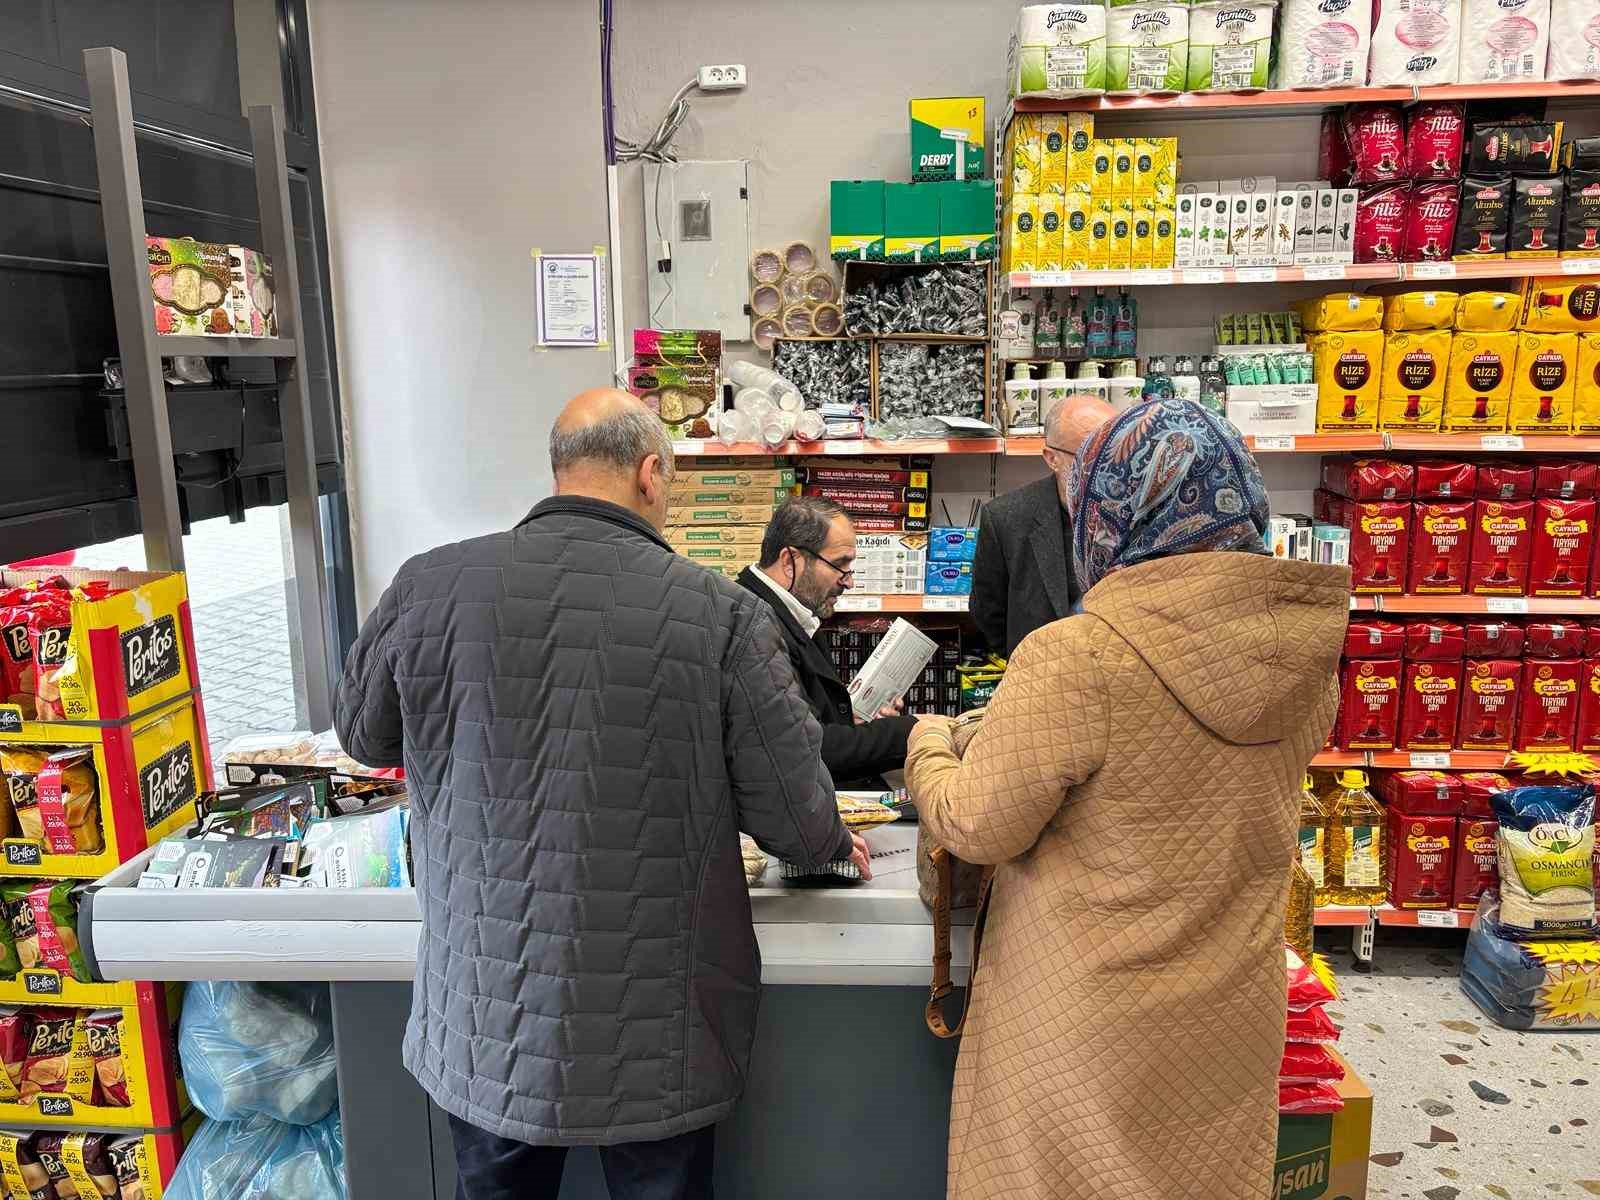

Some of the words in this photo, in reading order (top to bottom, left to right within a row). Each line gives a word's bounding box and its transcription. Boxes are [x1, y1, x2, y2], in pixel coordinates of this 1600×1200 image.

[1047, 8, 1087, 29] familia
[1132, 11, 1170, 30] familia
[1216, 8, 1256, 29] familia
[1428, 116, 1461, 135] filiz
[920, 153, 954, 166] DERBY
[1368, 203, 1400, 221] filiz
[1420, 204, 1452, 222] filiz
[1341, 365, 1365, 376] RİZE
[1405, 364, 1430, 375] RİZE
[1473, 366, 1498, 377] RİZE
[1537, 366, 1561, 376] RİZE
[782, 472, 793, 480] 10
[865, 536, 890, 548] Kağıdı
[126, 625, 173, 687] Peritos
[147, 753, 189, 818] Peritos
[9, 844, 37, 861] Peritos
[1271, 1158, 1325, 1200] ysan
